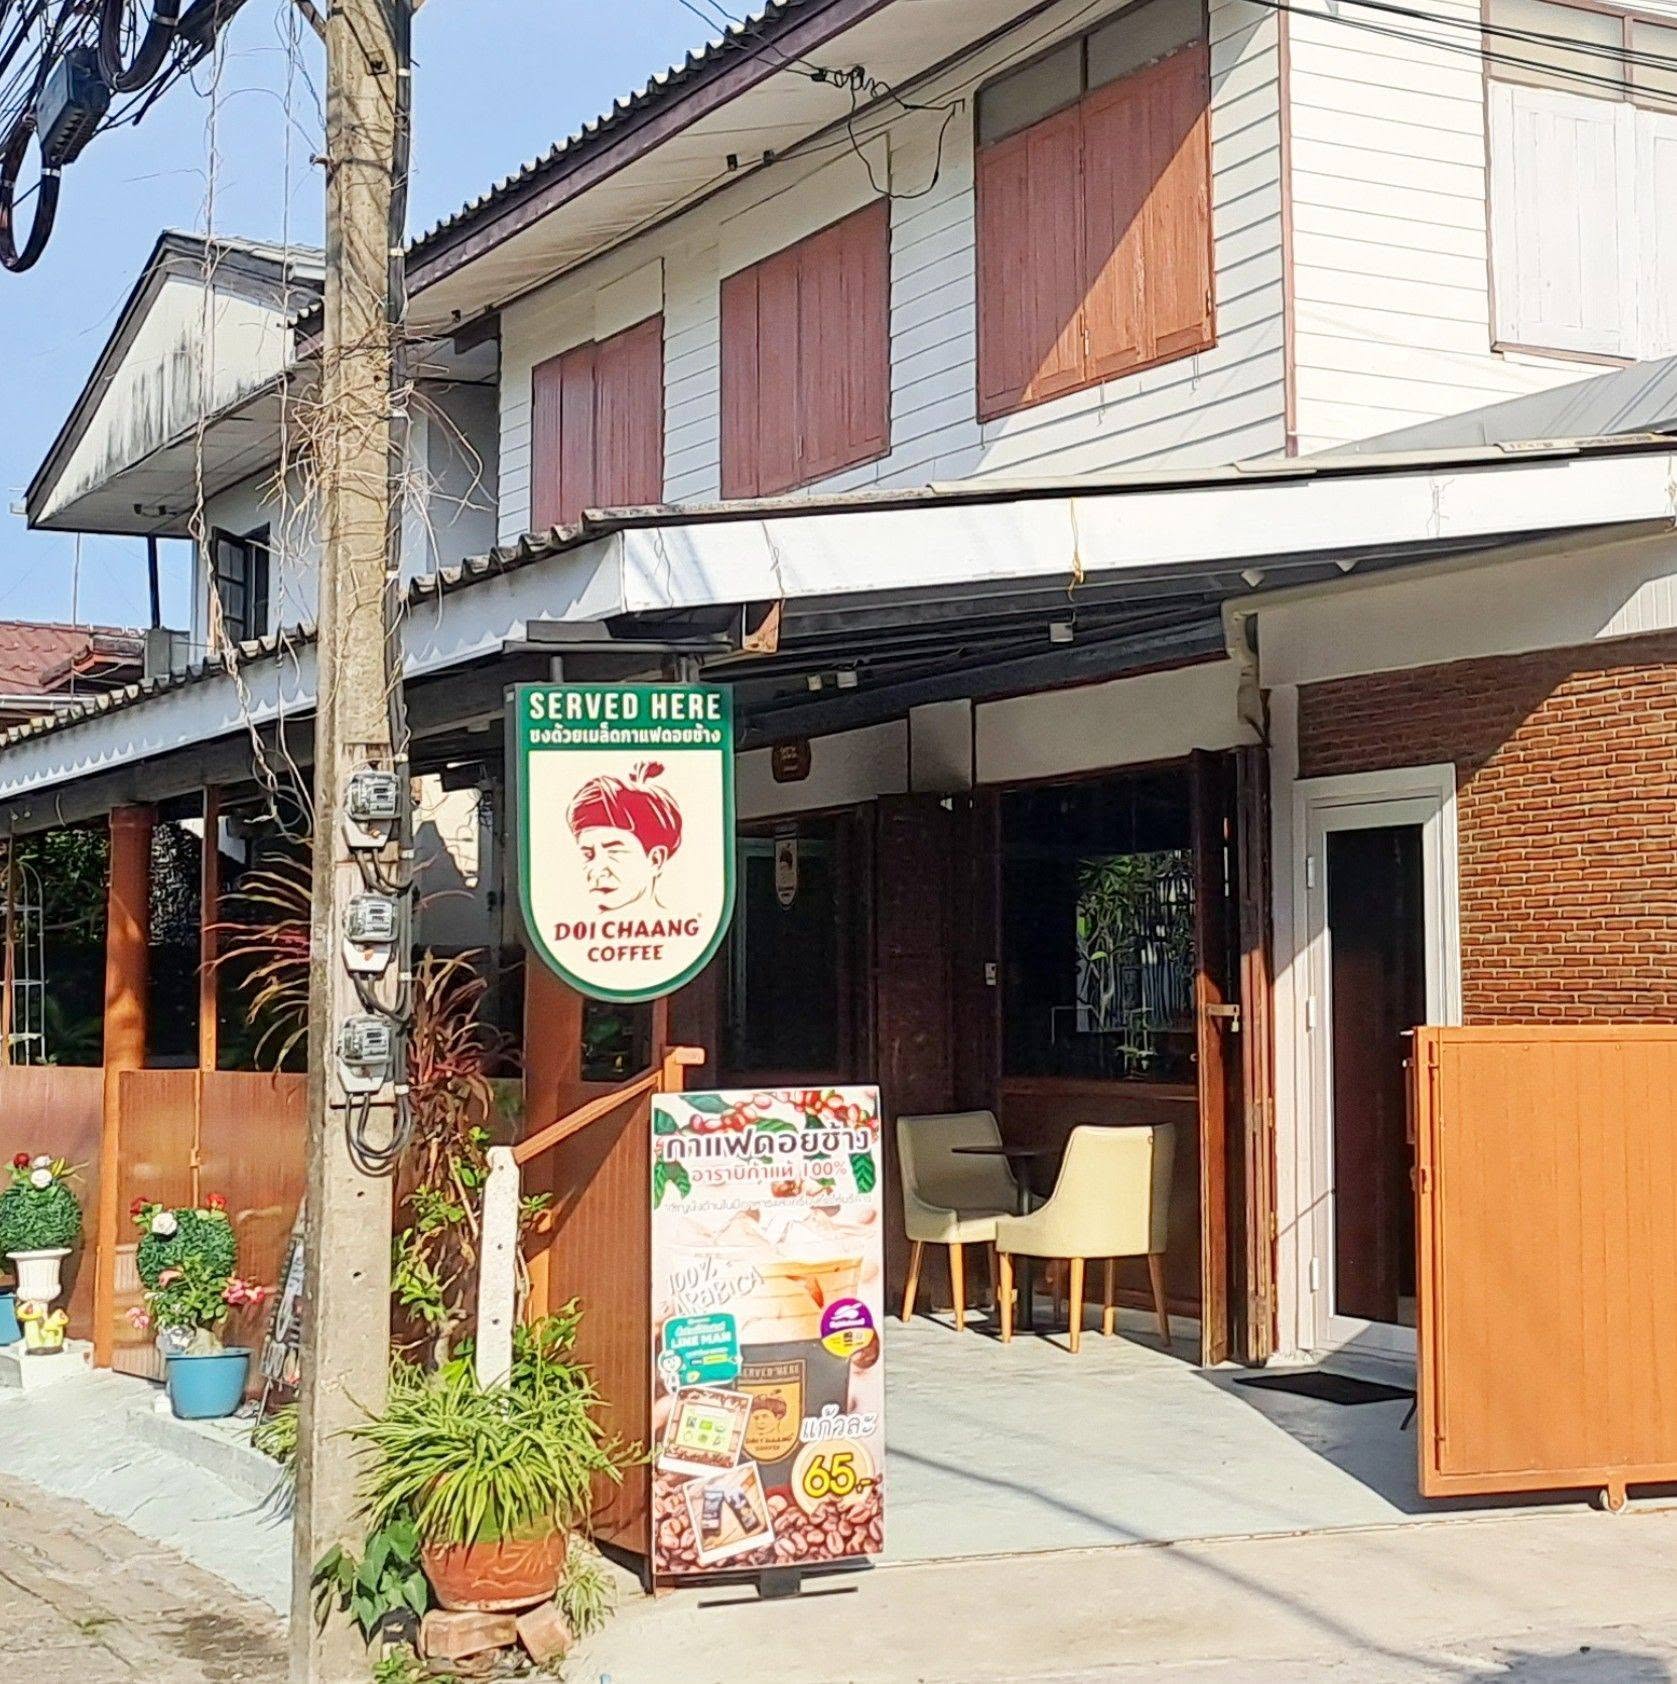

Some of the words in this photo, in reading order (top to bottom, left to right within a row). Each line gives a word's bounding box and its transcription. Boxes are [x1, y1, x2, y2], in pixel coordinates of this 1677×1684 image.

[529, 692, 639, 720] SERVED
[651, 692, 721, 720] HERE
[529, 721, 721, 744] ชงด้วยเมล็ดกาแฟดอยช้าง
[554, 922, 596, 941] DOI
[601, 918, 699, 939] CHAANG
[587, 944, 664, 962] COFFEE
[666, 1122, 869, 1159] กาแฟดอยช้าง
[692, 1160, 793, 1182] อาราบิก้าแท้
[803, 1161, 847, 1177] 100%
